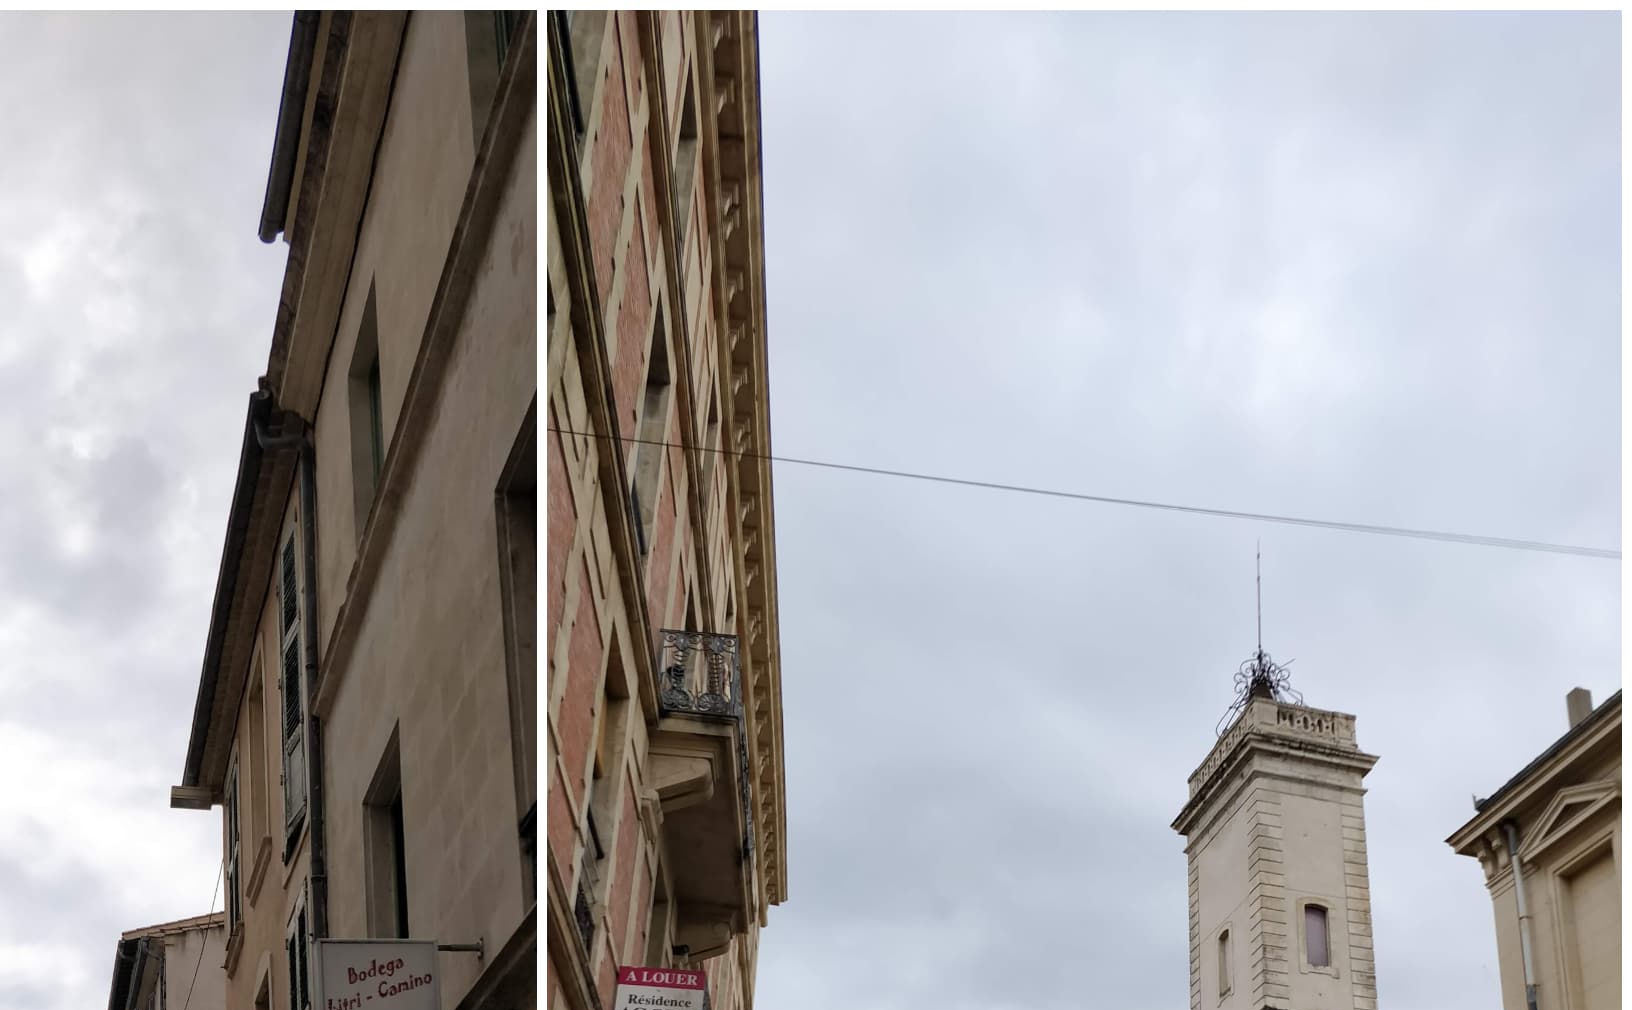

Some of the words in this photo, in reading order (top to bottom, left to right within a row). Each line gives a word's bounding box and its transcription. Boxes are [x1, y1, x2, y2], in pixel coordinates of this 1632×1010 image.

[348, 958, 404, 984] Bodega
[625, 971, 637, 982] A
[642, 971, 698, 986] LOUER
[378, 973, 432, 998] Camino
[628, 994, 692, 1008] Résidence
